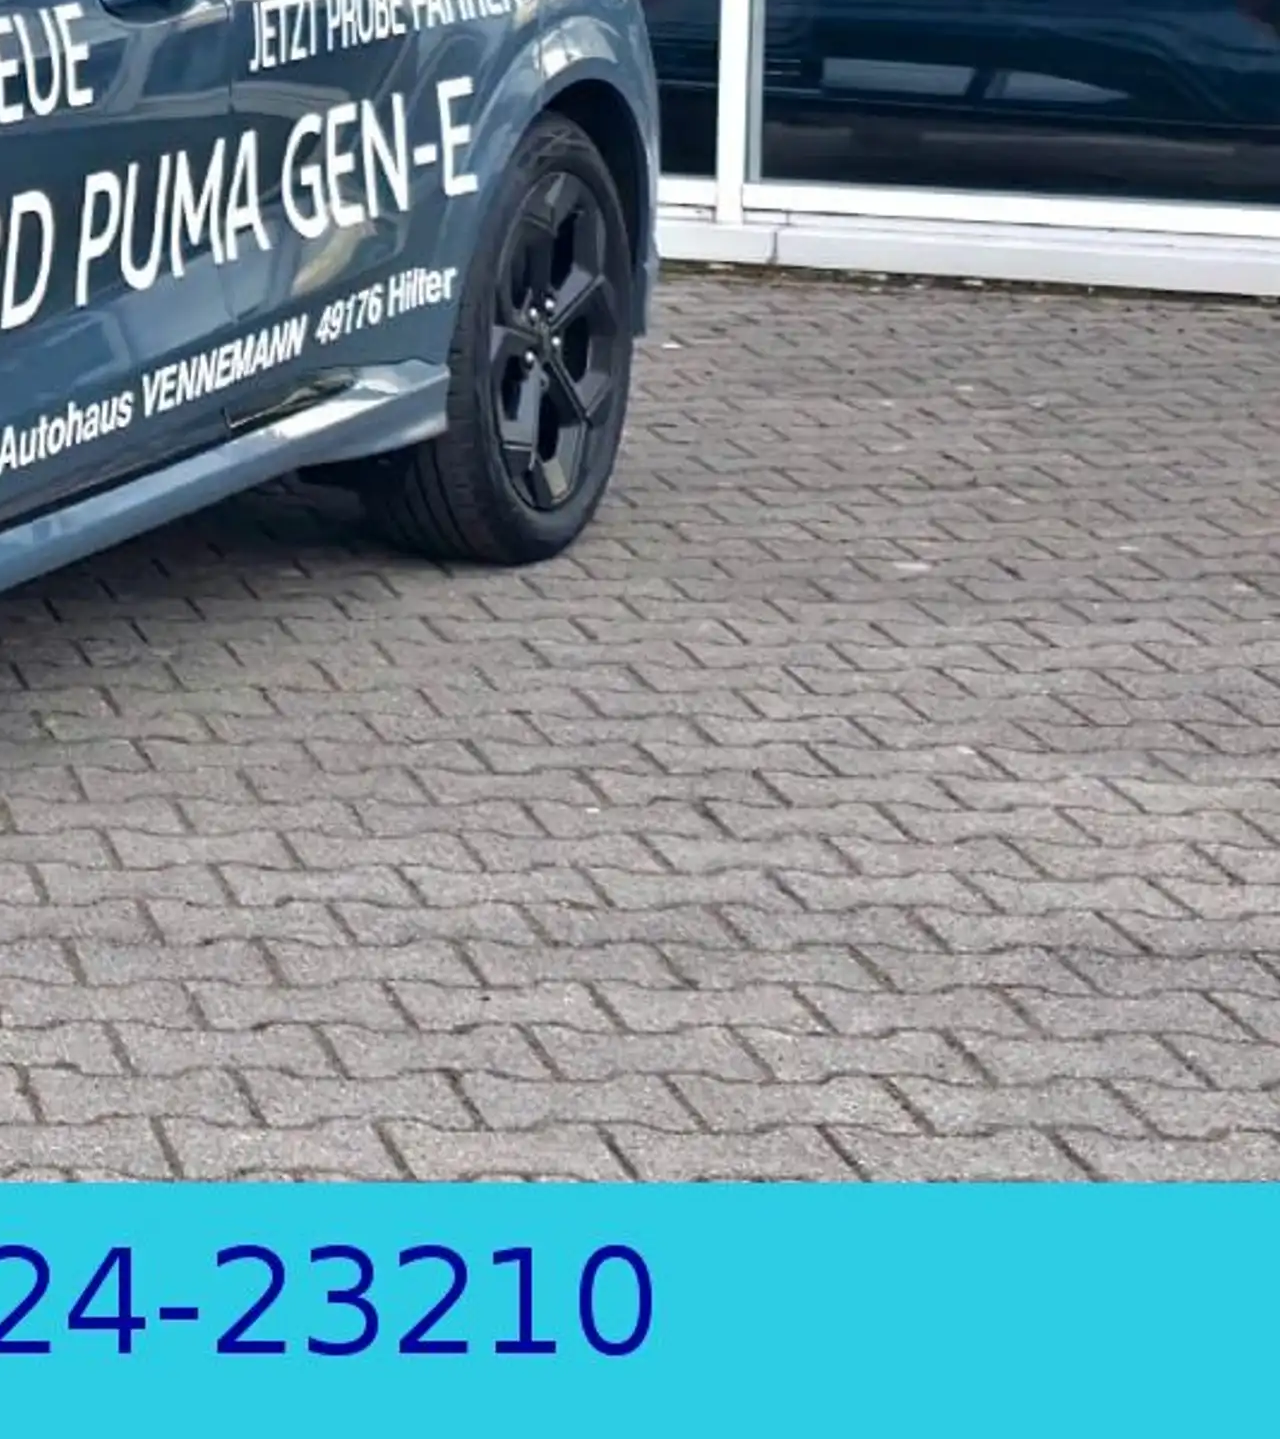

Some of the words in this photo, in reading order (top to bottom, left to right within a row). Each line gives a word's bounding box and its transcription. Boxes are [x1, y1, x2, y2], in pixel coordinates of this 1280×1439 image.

[75, 129, 270, 307] PUMA
[280, 75, 479, 241] GEN-E
[141, 313, 308, 419] VENNEMANN
[315, 282, 385, 345] 49176
[387, 266, 458, 318] Hilter
